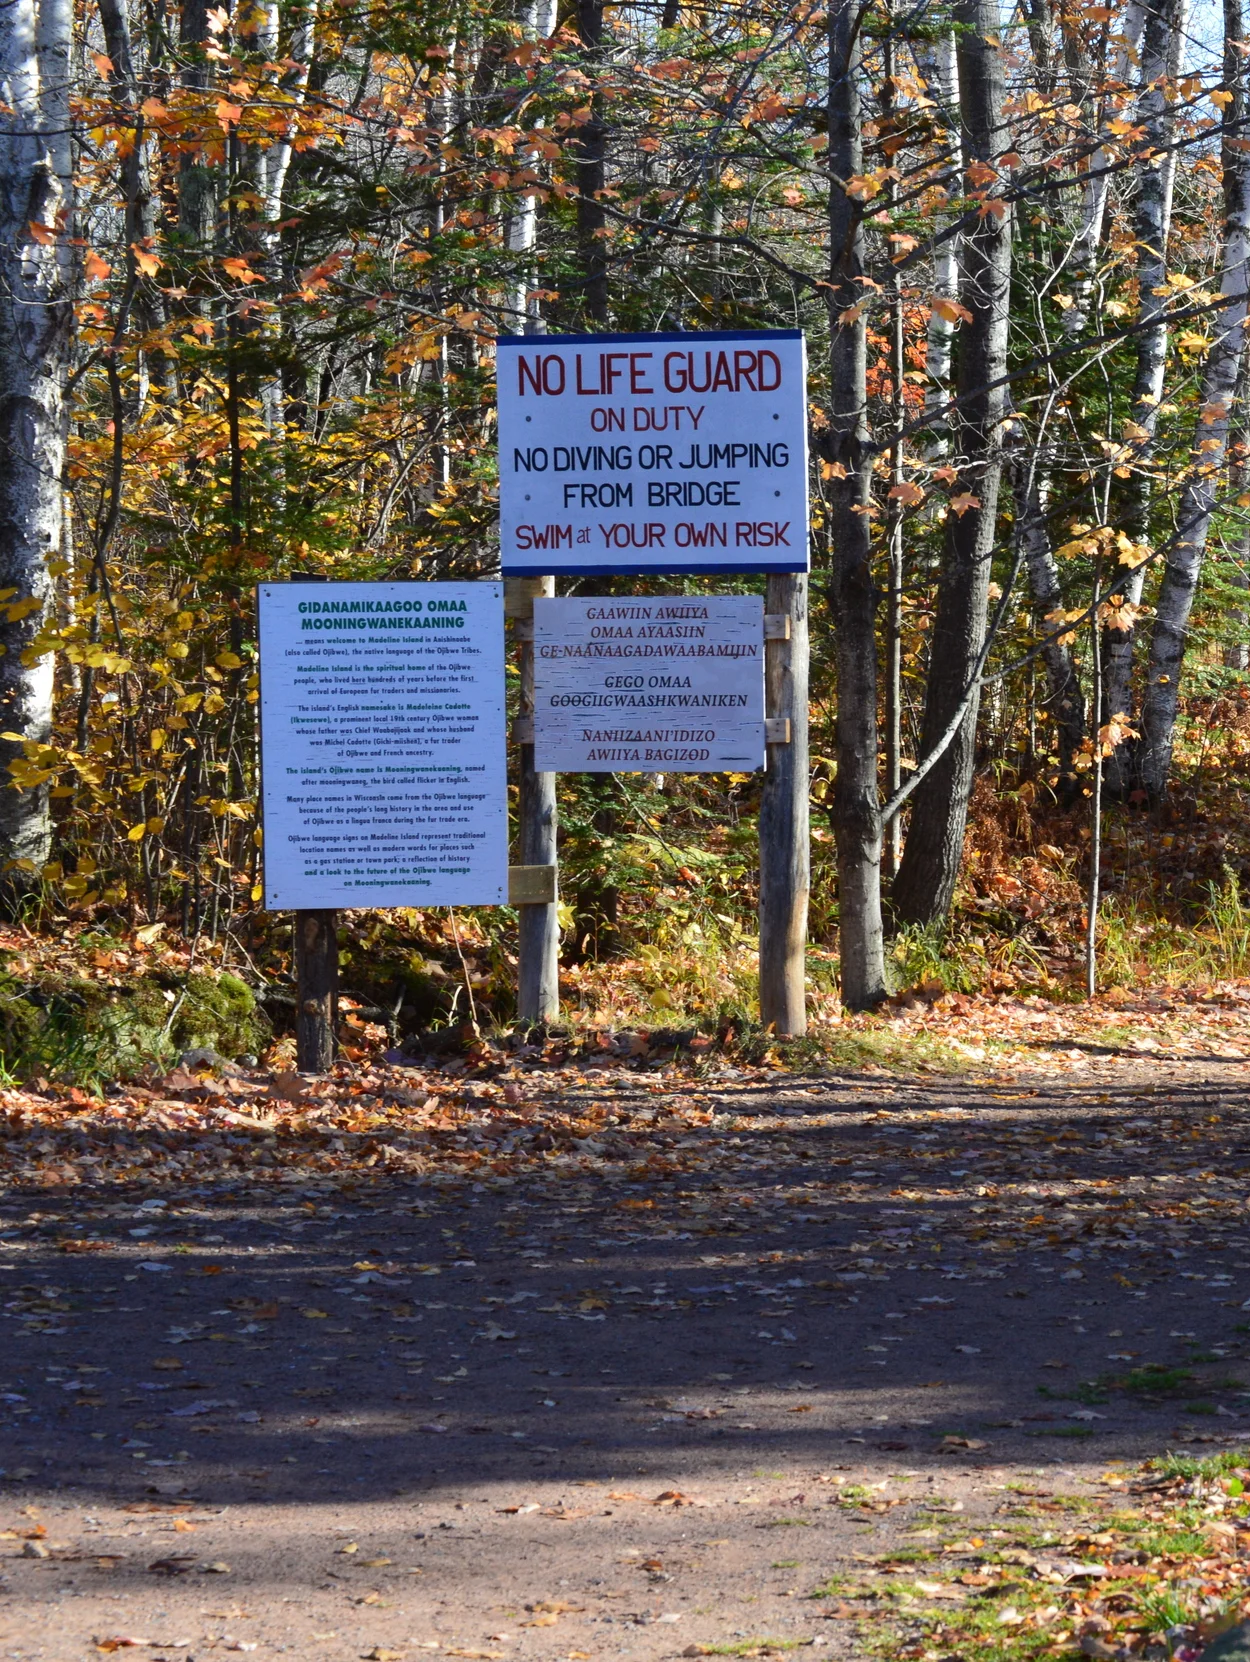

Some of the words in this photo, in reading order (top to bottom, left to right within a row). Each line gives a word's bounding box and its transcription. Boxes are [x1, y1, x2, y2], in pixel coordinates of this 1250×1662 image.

[518, 354, 565, 396] NO
[577, 353, 653, 395] LIFE
[664, 350, 782, 393] GUARD
[590, 407, 625, 432] ON
[634, 405, 705, 432] DUTY
[514, 447, 548, 472] NO
[554, 445, 632, 471] DIVING
[639, 444, 672, 470] OR
[679, 443, 789, 469] JUMPING
[564, 483, 633, 509] FROM
[648, 481, 740, 506] BRIDGE
[516, 525, 572, 550] SWIM
[577, 525, 590, 544] at
[598, 523, 666, 548] YOUR
[674, 522, 727, 547] OWN
[736, 521, 791, 547] RISK
[298, 601, 422, 613] GIDANAMIKAAGOO
[428, 601, 467, 612] OMAA
[587, 607, 651, 619] GAAWIIN
[655, 607, 709, 619] AWIIYA
[301, 617, 464, 630] MOONINGWANEKAANING
[591, 626, 633, 638] OMAA
[638, 626, 705, 637] AYAASIIN
[327, 636, 356, 644] welcome
[425, 635, 432, 643] in
[285, 648, 300, 656] (also
[386, 647, 414, 656] language
[424, 646, 435, 654] the
[437, 646, 459, 655] Ojibwe
[540, 644, 758, 659] GE-NAANAAGADAWAABAMIJIN
[297, 664, 329, 672] Madeline
[376, 664, 405, 673] spiritual
[407, 663, 426, 671] home
[448, 663, 471, 672] Ojibwe
[294, 676, 316, 685] people,
[334, 675, 350, 683] lived
[352, 675, 366, 683] here
[407, 676, 424, 684] years
[605, 676, 644, 688] GEGO
[649, 675, 691, 687] OMAA
[308, 687, 329, 695] arrival
[339, 687, 368, 696] European
[370, 686, 380, 694] fur
[550, 694, 748, 707] GOOGIIGWAASHKWANIKEN
[337, 703, 359, 713] English
[361, 703, 396, 711] namesake
[406, 702, 443, 710] Madeleine
[587, 749, 639, 761] AWIIYA
[645, 749, 710, 761] BAGIZOD
[286, 766, 298, 774] The
[329, 765, 353, 775] Ojibwe
[371, 776, 381, 784] the
[383, 776, 395, 784] bird
[438, 775, 444, 783] in
[446, 775, 470, 784] English.
[287, 795, 304, 804] Many
[306, 794, 322, 803] place
[354, 793, 385, 801] Wisconsin
[434, 792, 456, 802] Ojibwe
[458, 792, 486, 801] language
[335, 805, 345, 813] the
[346, 805, 372, 814] people's
[374, 805, 388, 814] long
[390, 804, 412, 814] history
[450, 803, 461, 811] and
[288, 834, 310, 843] Ojibwe
[312, 833, 341, 843] language
[342, 833, 358, 842] signs
[370, 832, 399, 840] Madeline
[421, 832, 451, 841] represent
[453, 831, 486, 839] traditional
[304, 868, 317, 876] and
[353, 867, 365, 875] the
[399, 866, 410, 874] the
[412, 866, 437, 875] Ojibwe
[439, 865, 471, 875] language
